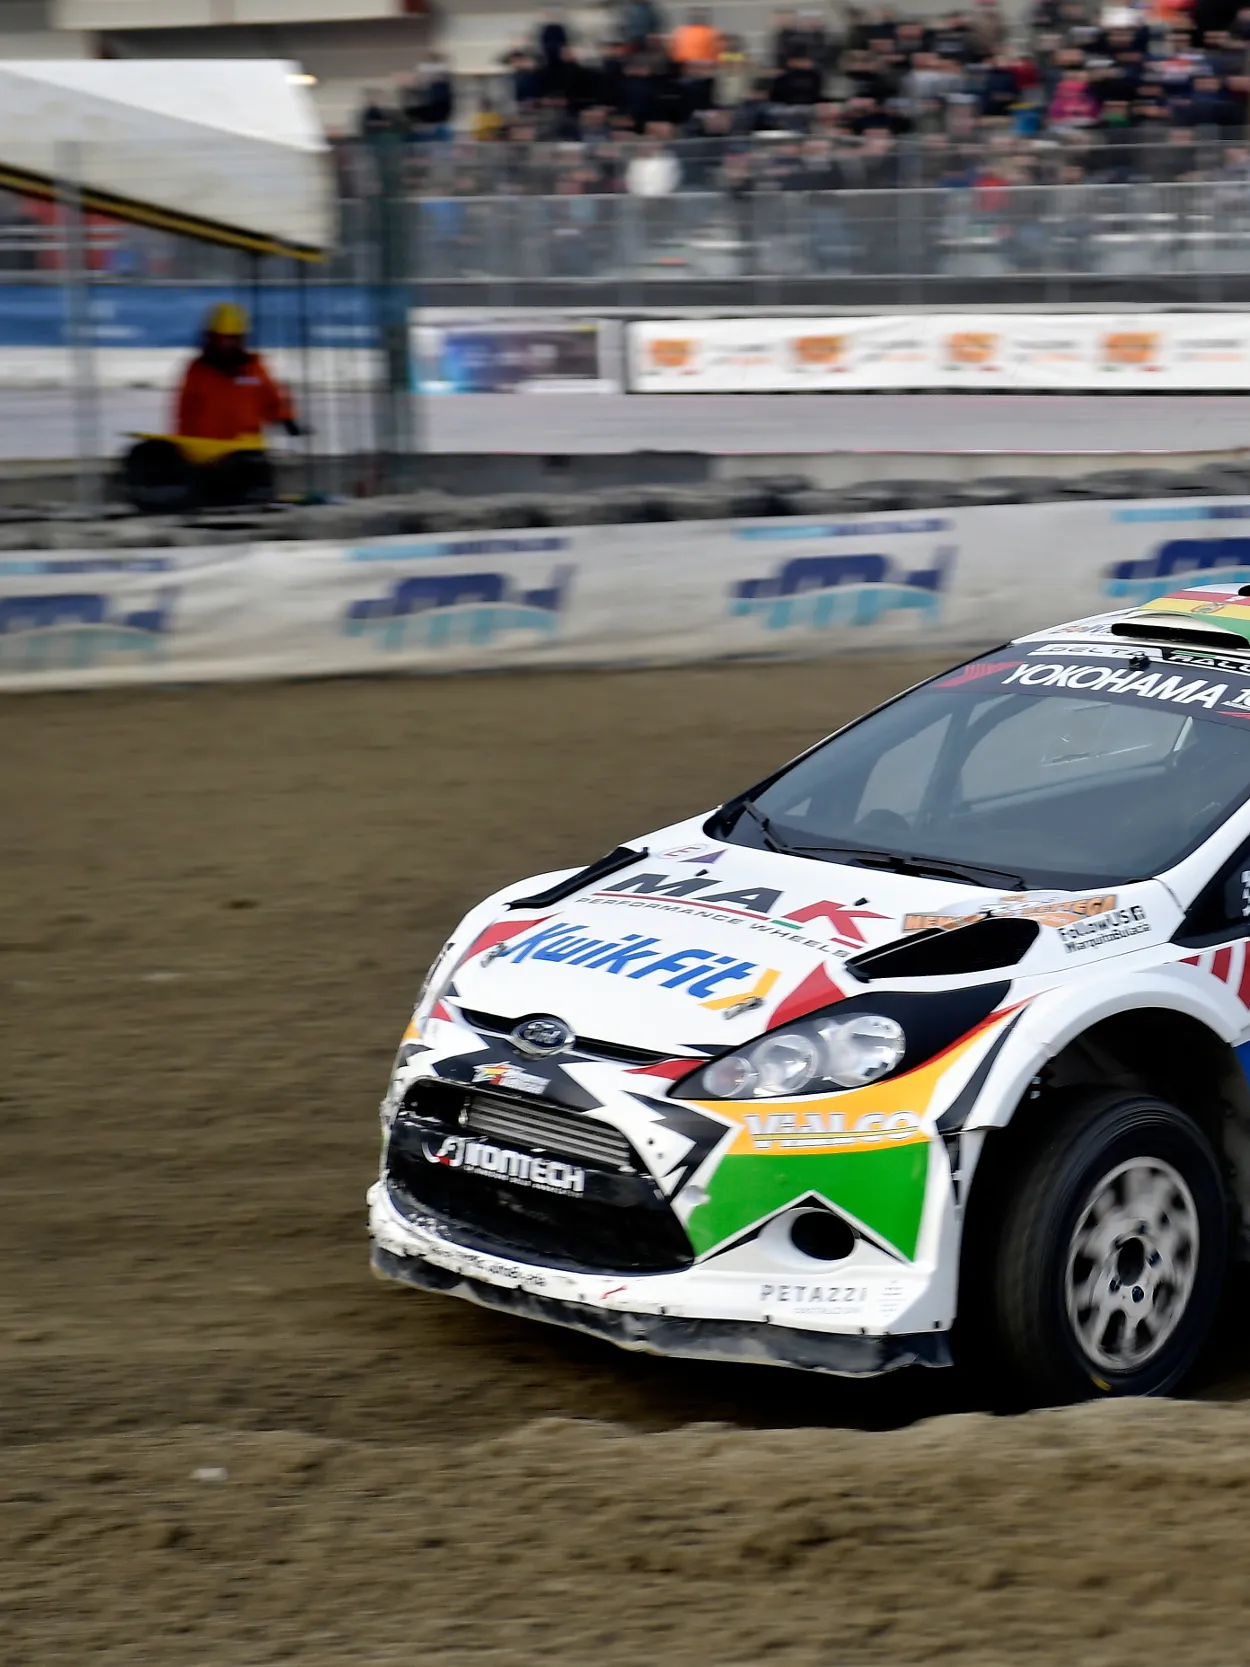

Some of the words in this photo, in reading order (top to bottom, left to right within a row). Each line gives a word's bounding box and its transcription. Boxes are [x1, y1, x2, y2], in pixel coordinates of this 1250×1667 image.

[1001, 663, 1230, 710] YOKOHAMA
[575, 896, 746, 925] PERFORMANCE
[749, 921, 852, 958] WHEELS
[601, 872, 893, 944] MAK
[760, 1284, 868, 1302] PETAZZI
